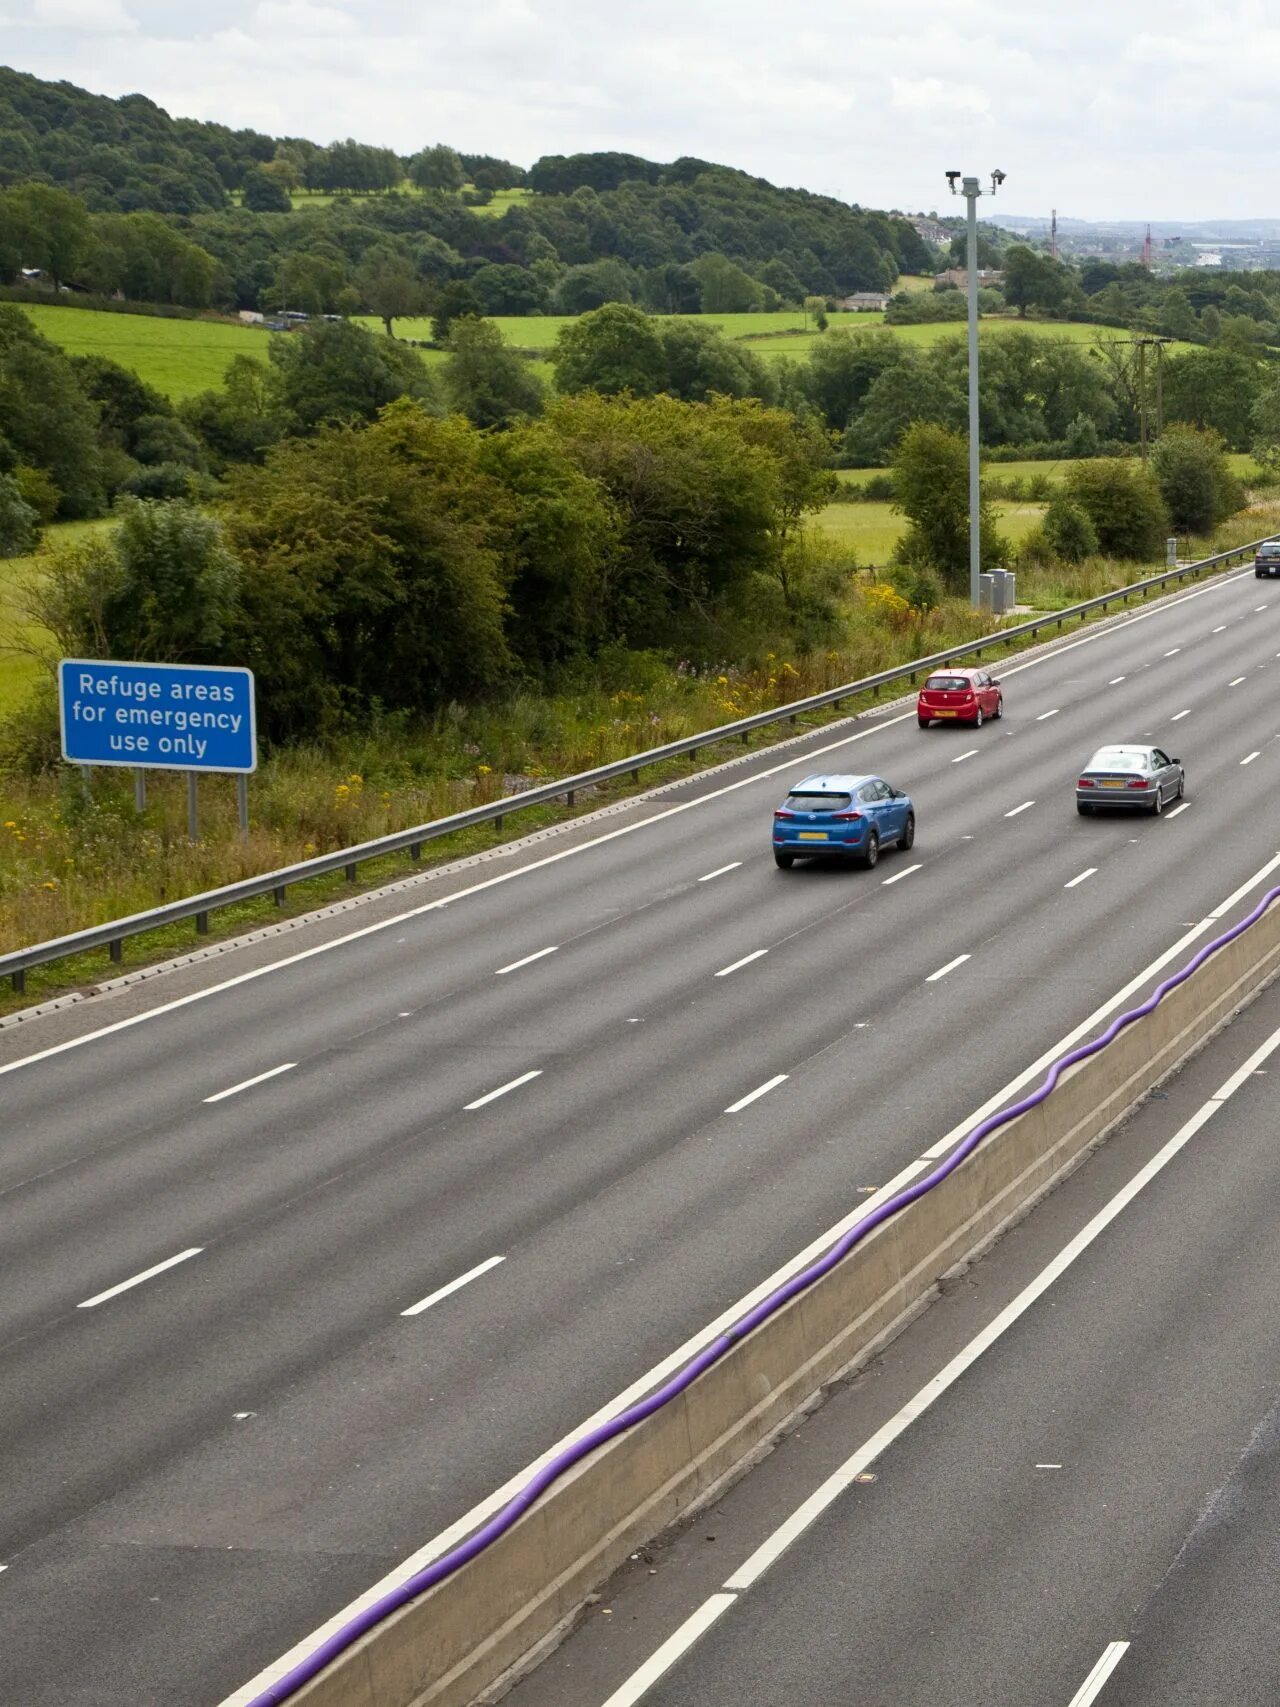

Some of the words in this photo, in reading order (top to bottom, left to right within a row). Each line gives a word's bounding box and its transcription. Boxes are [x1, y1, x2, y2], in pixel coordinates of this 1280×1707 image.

[79, 673, 162, 701] Refuge
[171, 683, 235, 702] areas
[73, 701, 106, 722] for
[115, 707, 242, 733] emergency
[110, 734, 150, 751] use
[158, 734, 207, 759] only
